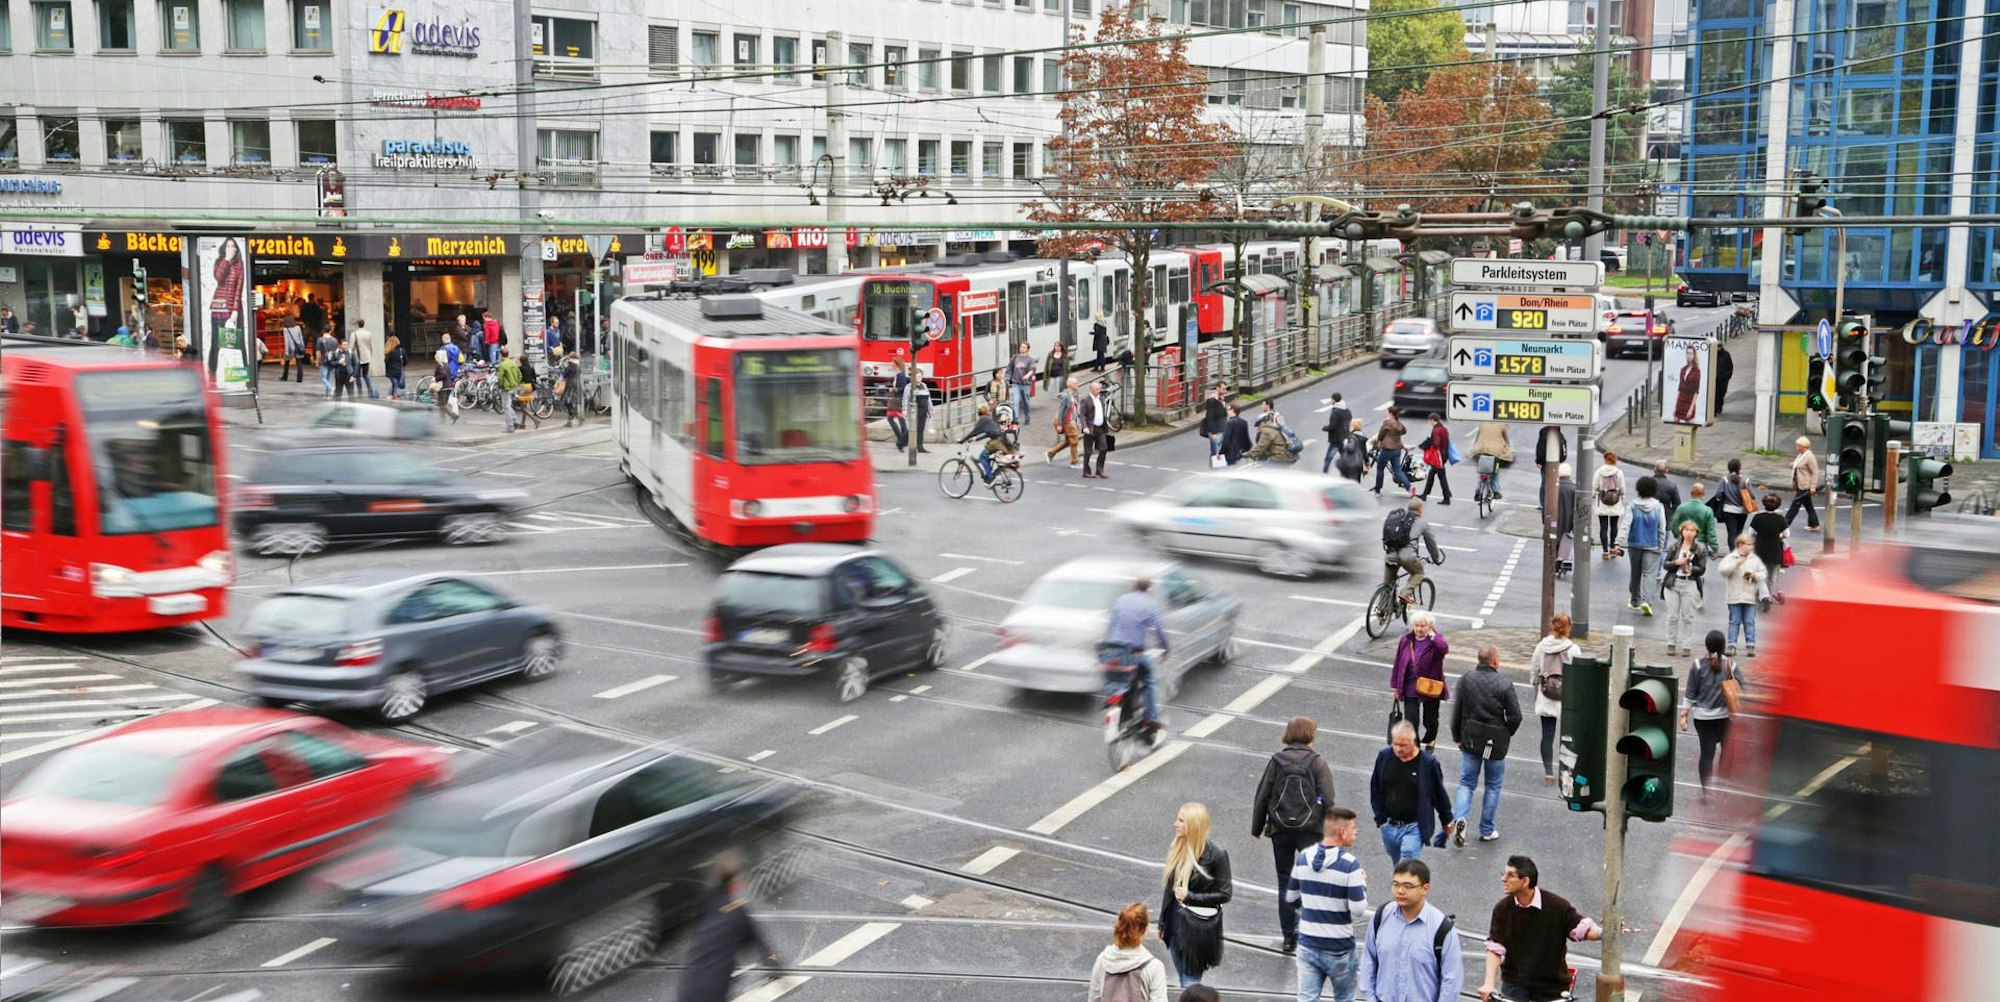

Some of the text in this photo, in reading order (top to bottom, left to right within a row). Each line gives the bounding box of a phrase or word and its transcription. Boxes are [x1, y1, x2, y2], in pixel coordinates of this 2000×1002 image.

[411, 16, 480, 48] adevis
[384, 137, 473, 156] paracelsus
[374, 153, 482, 171] heilpraktikerschule
[13, 225, 66, 246] adevis
[427, 235, 506, 256] Merzenich
[546, 247, 555, 259] 3
[1046, 267, 1054, 278] 4
[1481, 265, 1567, 282] Parkleitsystem
[1520, 297, 1569, 308] Dom/Rhein
[1511, 310, 1544, 328] 920
[1551, 319, 1588, 328] freie Plätze
[1521, 343, 1563, 354] Neumarkt
[1666, 341, 1708, 352] MANGO
[1499, 356, 1543, 374] 1578
[1550, 365, 1565, 373] freie
[1528, 388, 1553, 400] Ringe
[1497, 402, 1541, 420] 1480
[1548, 411, 1563, 419] freie
